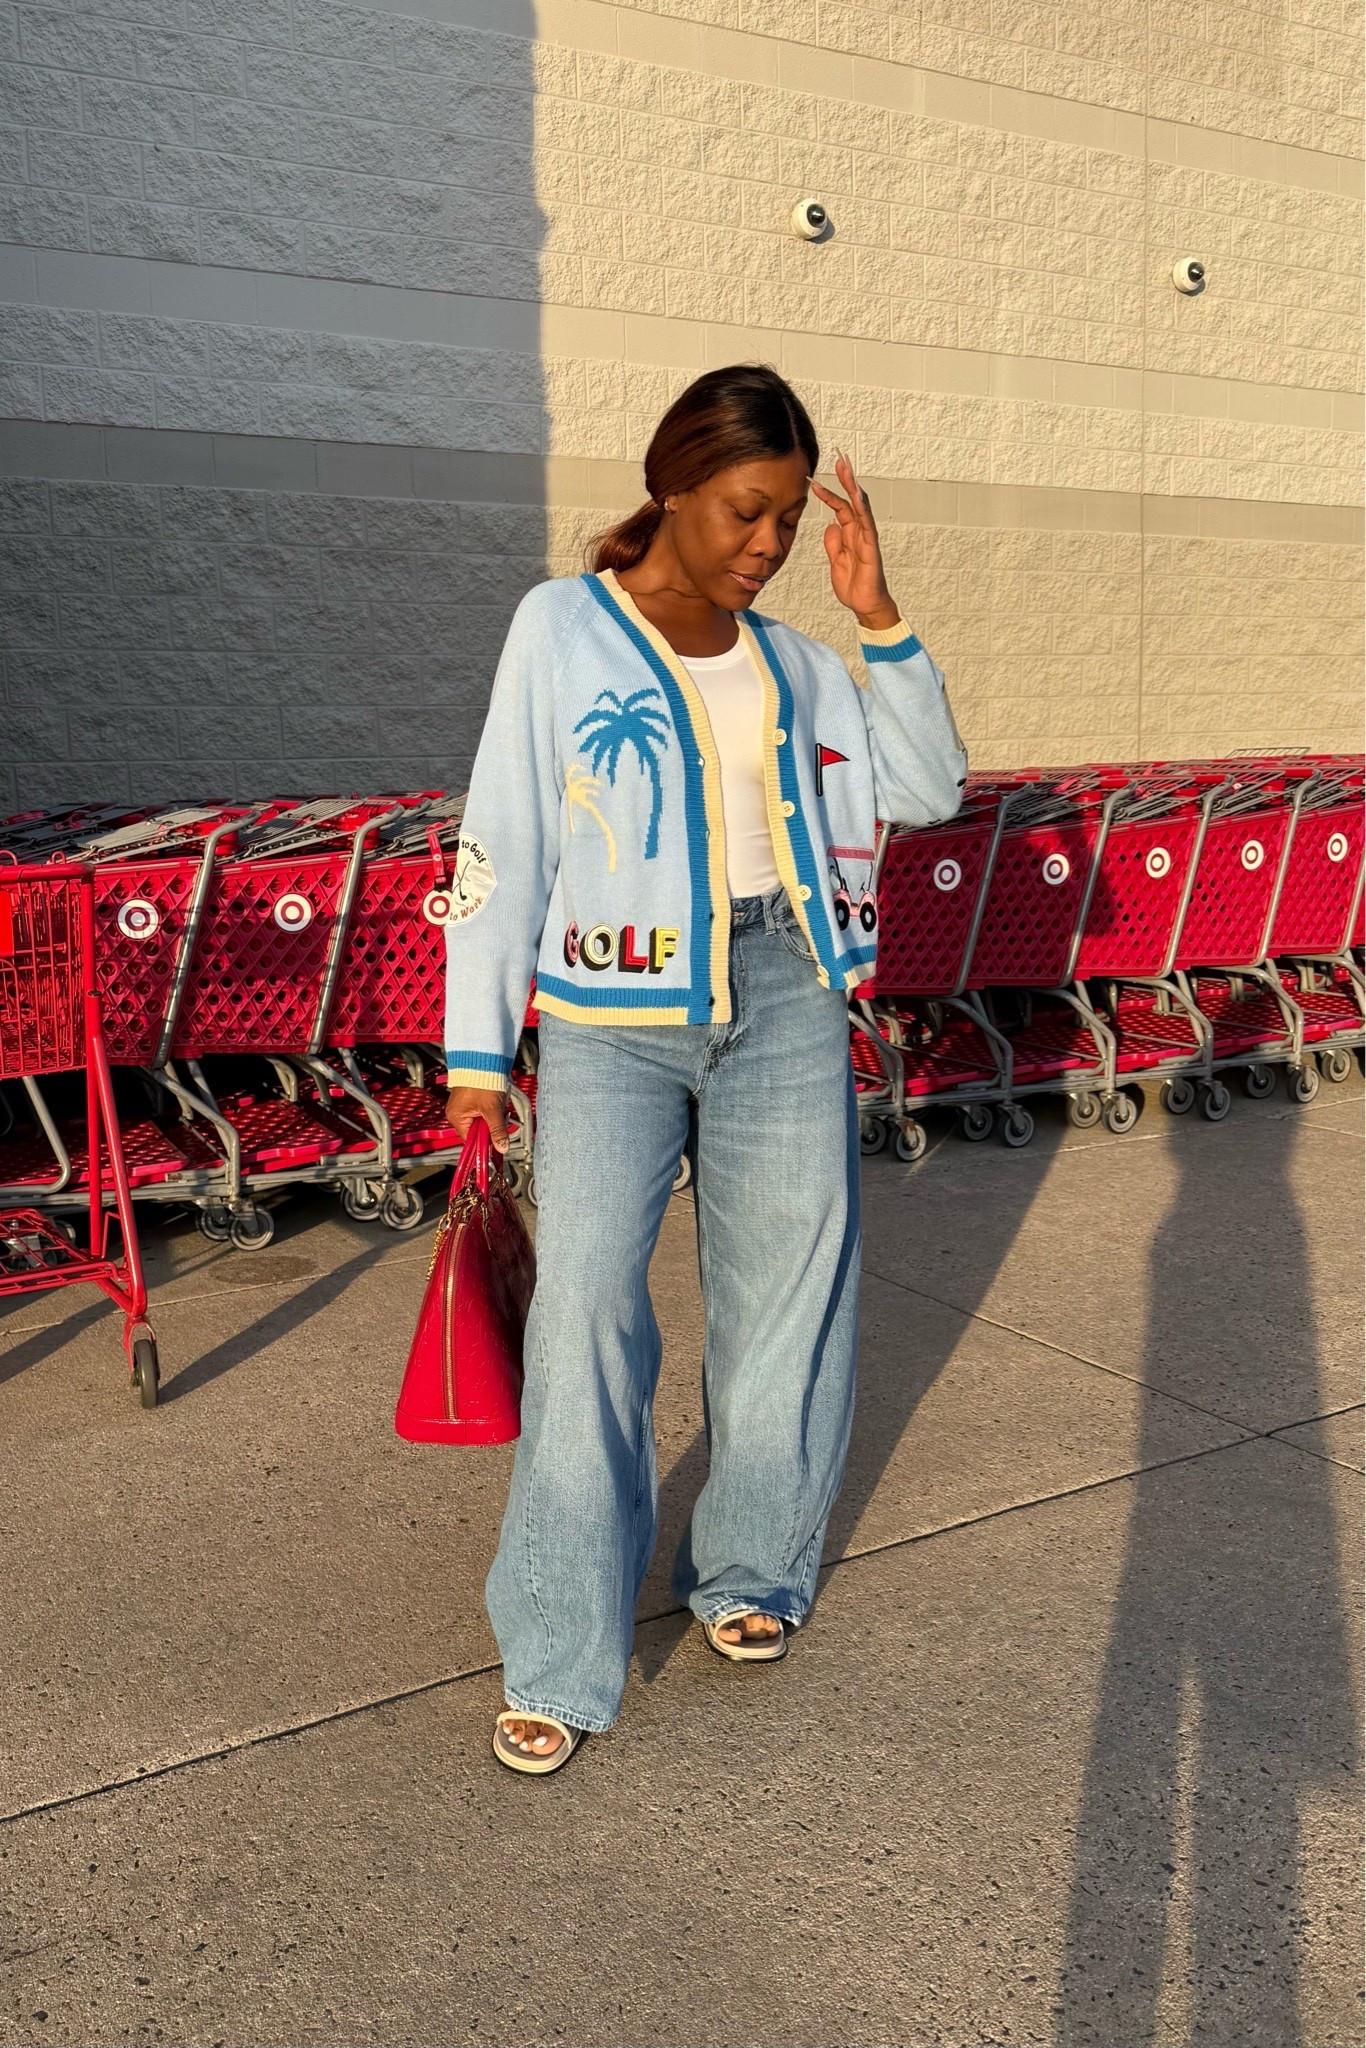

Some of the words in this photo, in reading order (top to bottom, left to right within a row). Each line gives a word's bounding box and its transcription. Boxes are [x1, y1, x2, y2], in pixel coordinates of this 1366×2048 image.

[461, 840, 470, 849] to
[470, 843, 486, 863] Golf
[564, 921, 680, 974] GOLF
